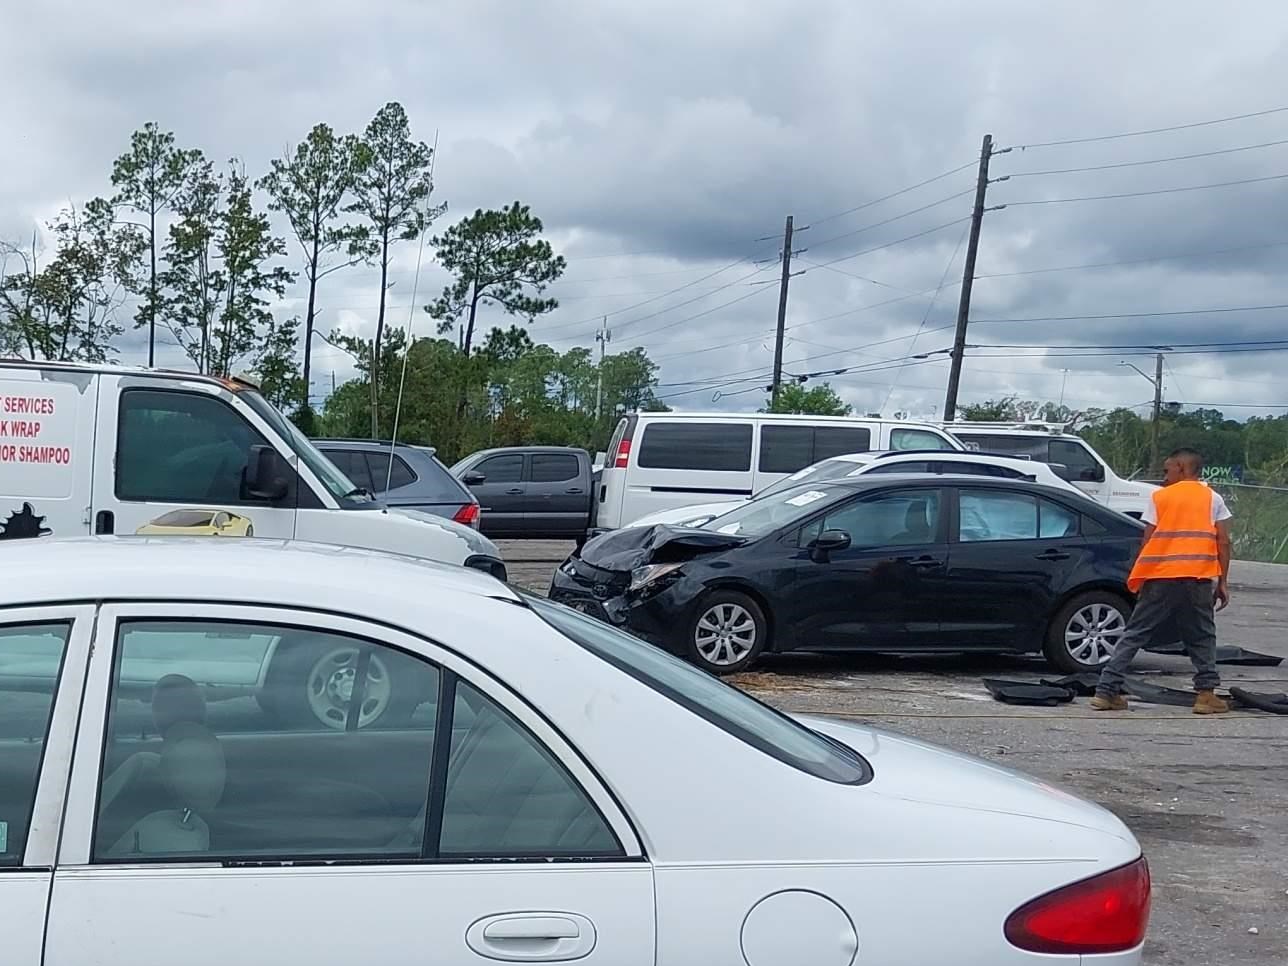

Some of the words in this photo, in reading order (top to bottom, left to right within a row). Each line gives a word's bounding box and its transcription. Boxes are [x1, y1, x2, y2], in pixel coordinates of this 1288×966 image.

[4, 398, 54, 414] SERVICES
[11, 421, 40, 438] WRAP
[19, 446, 70, 465] SHAMPOO
